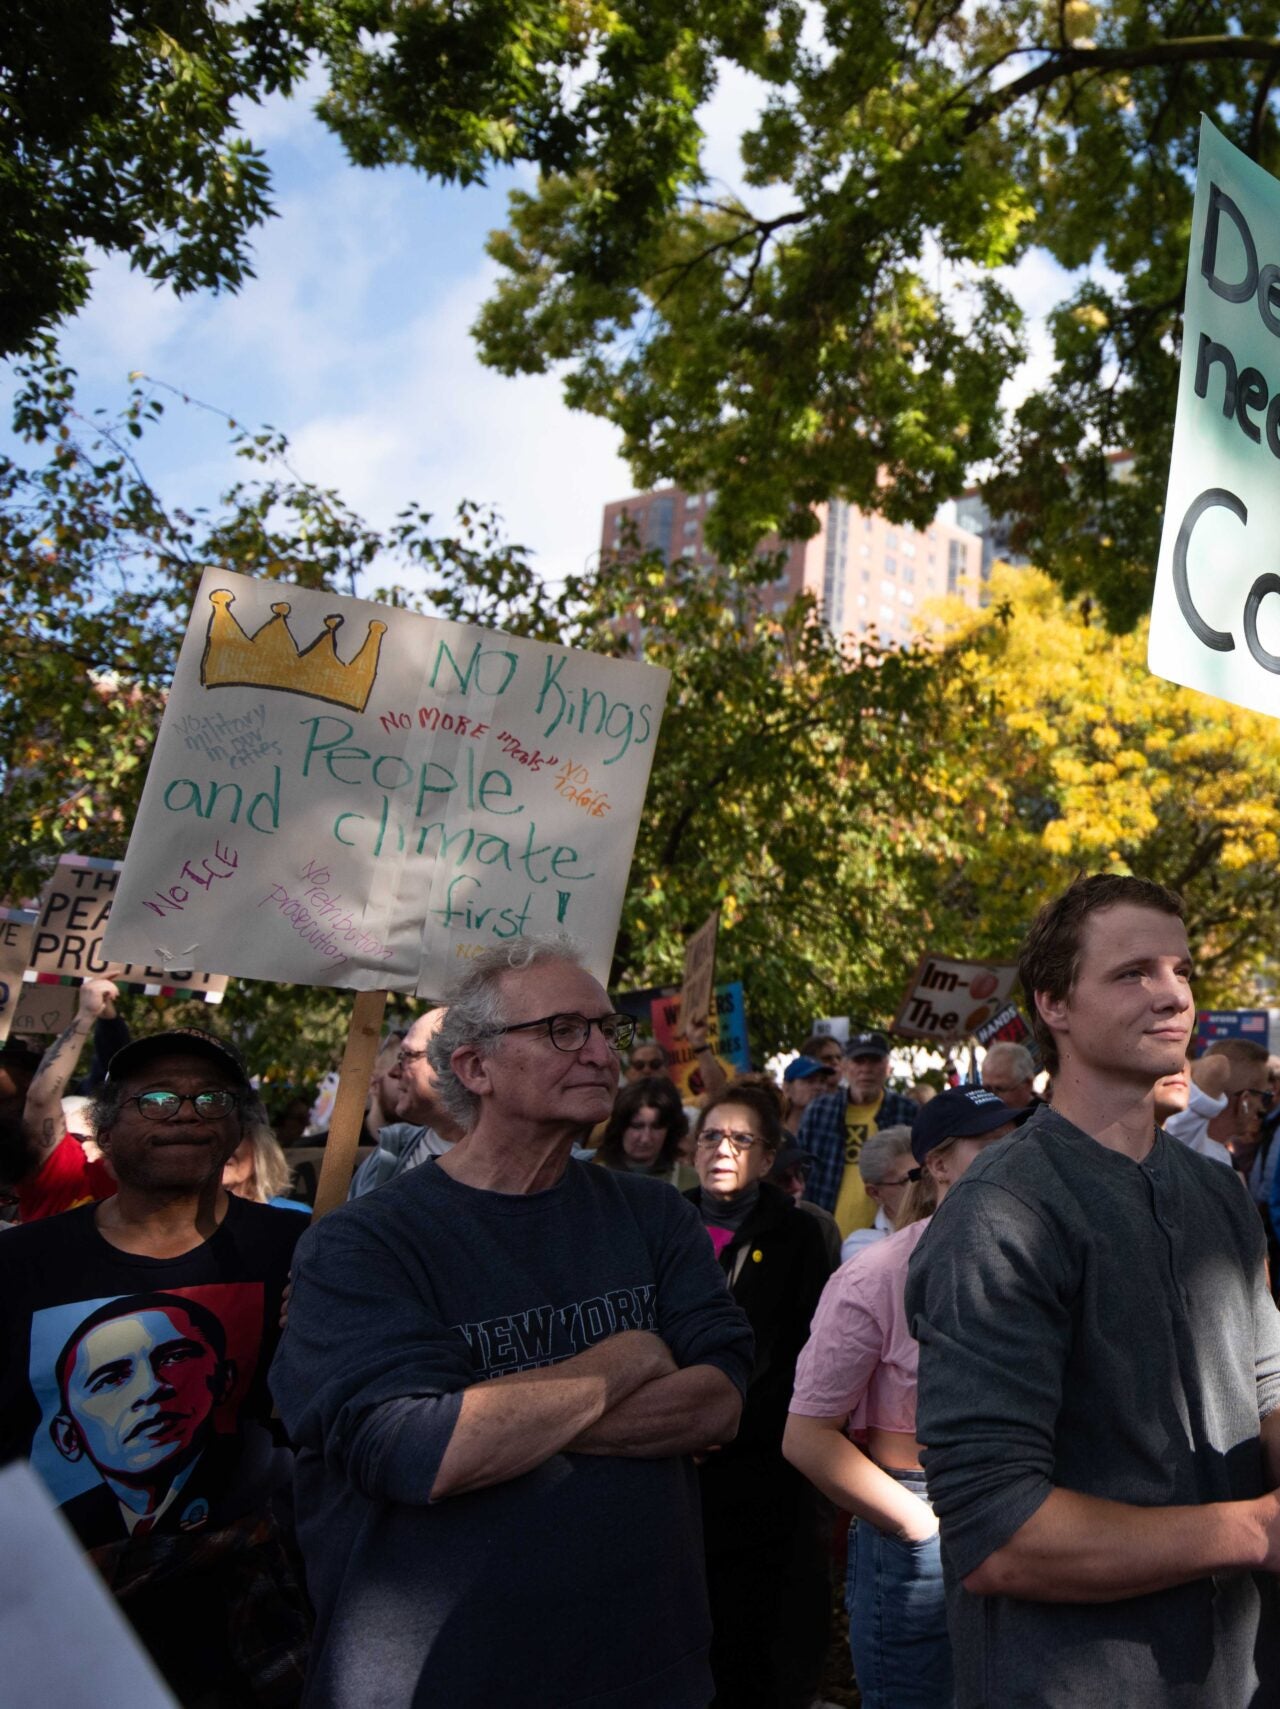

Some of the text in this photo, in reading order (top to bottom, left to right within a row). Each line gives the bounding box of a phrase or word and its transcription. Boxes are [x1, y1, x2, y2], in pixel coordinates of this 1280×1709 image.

[379, 710, 412, 734] NO
[418, 706, 490, 740] MORE
[429, 639, 652, 764] NO Kings
[300, 716, 524, 817] People
[164, 765, 595, 883] and climate
[71, 869, 121, 891] TH
[909, 1000, 960, 1031] The
